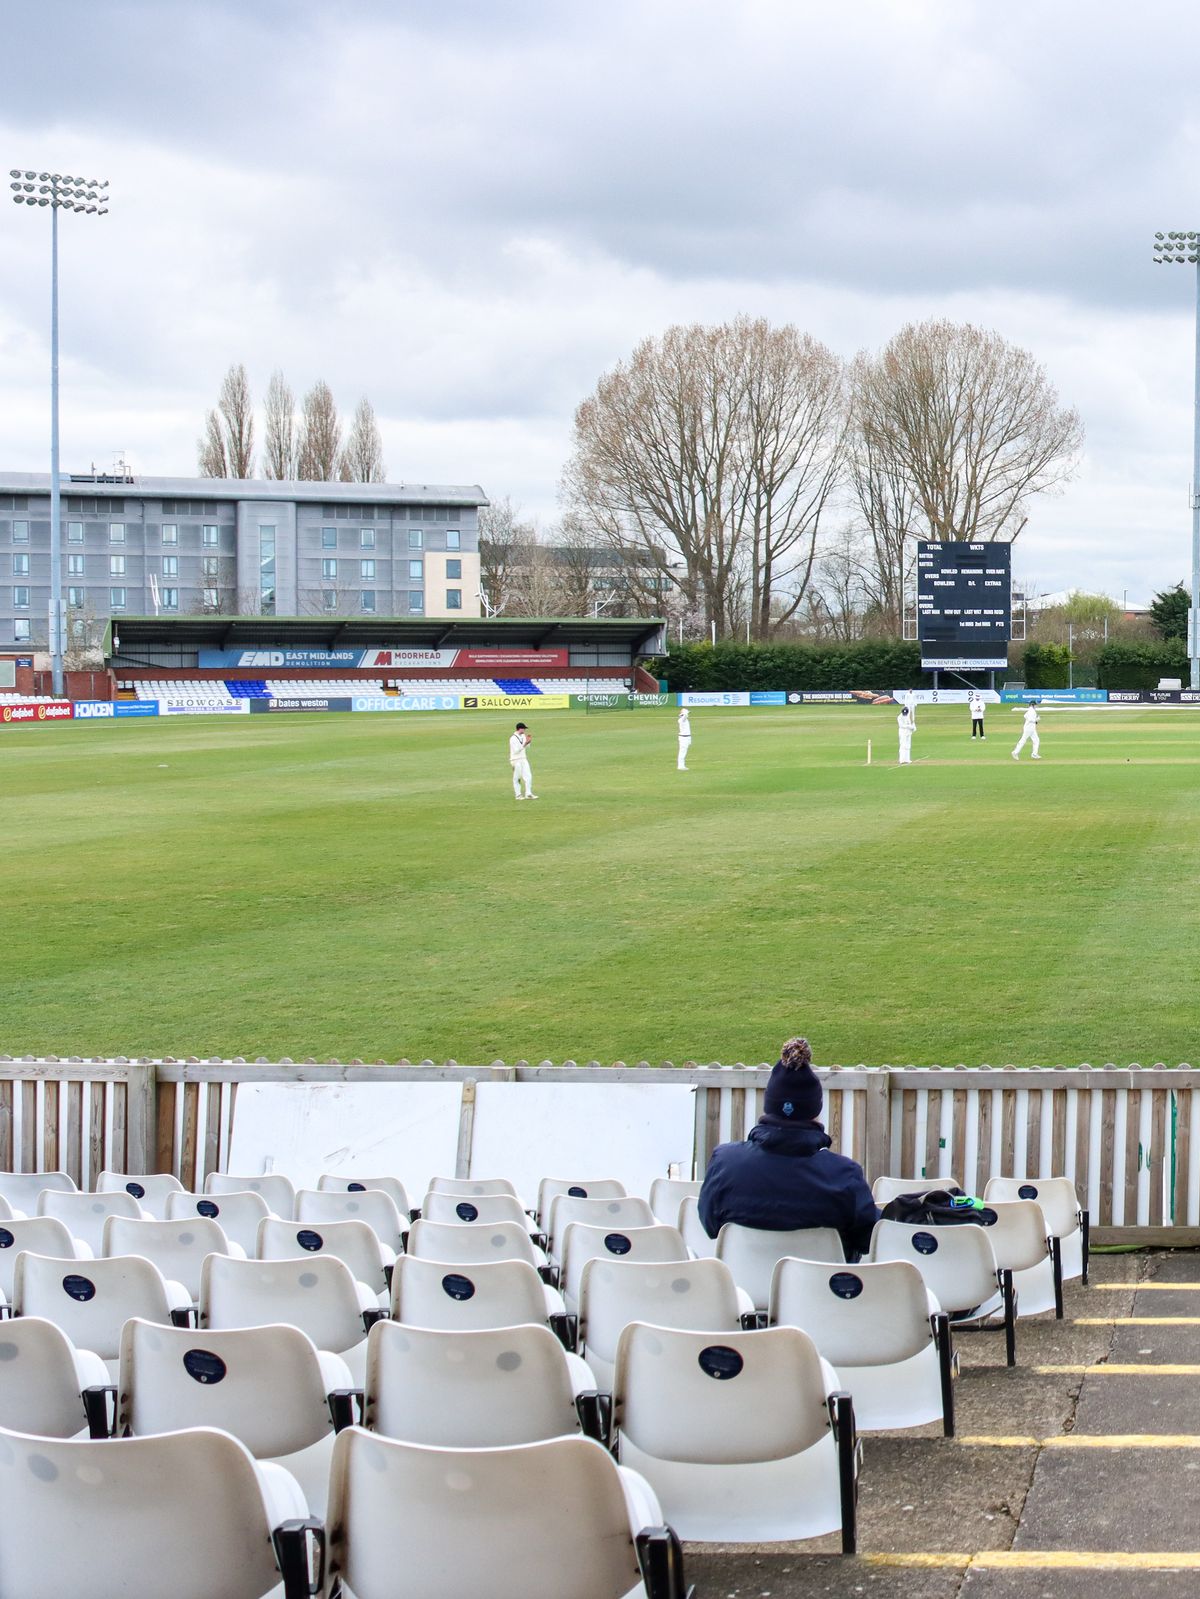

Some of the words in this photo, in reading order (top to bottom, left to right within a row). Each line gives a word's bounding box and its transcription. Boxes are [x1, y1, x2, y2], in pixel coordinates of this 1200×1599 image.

[238, 652, 284, 666] EMD
[356, 698, 435, 710] OFFICECARE
[481, 698, 532, 707] SALLOWAY
[723, 694, 730, 704] 5
[12, 708, 33, 719] dafabet
[46, 706, 70, 716] dafabet
[76, 703, 114, 717] HOWDEN
